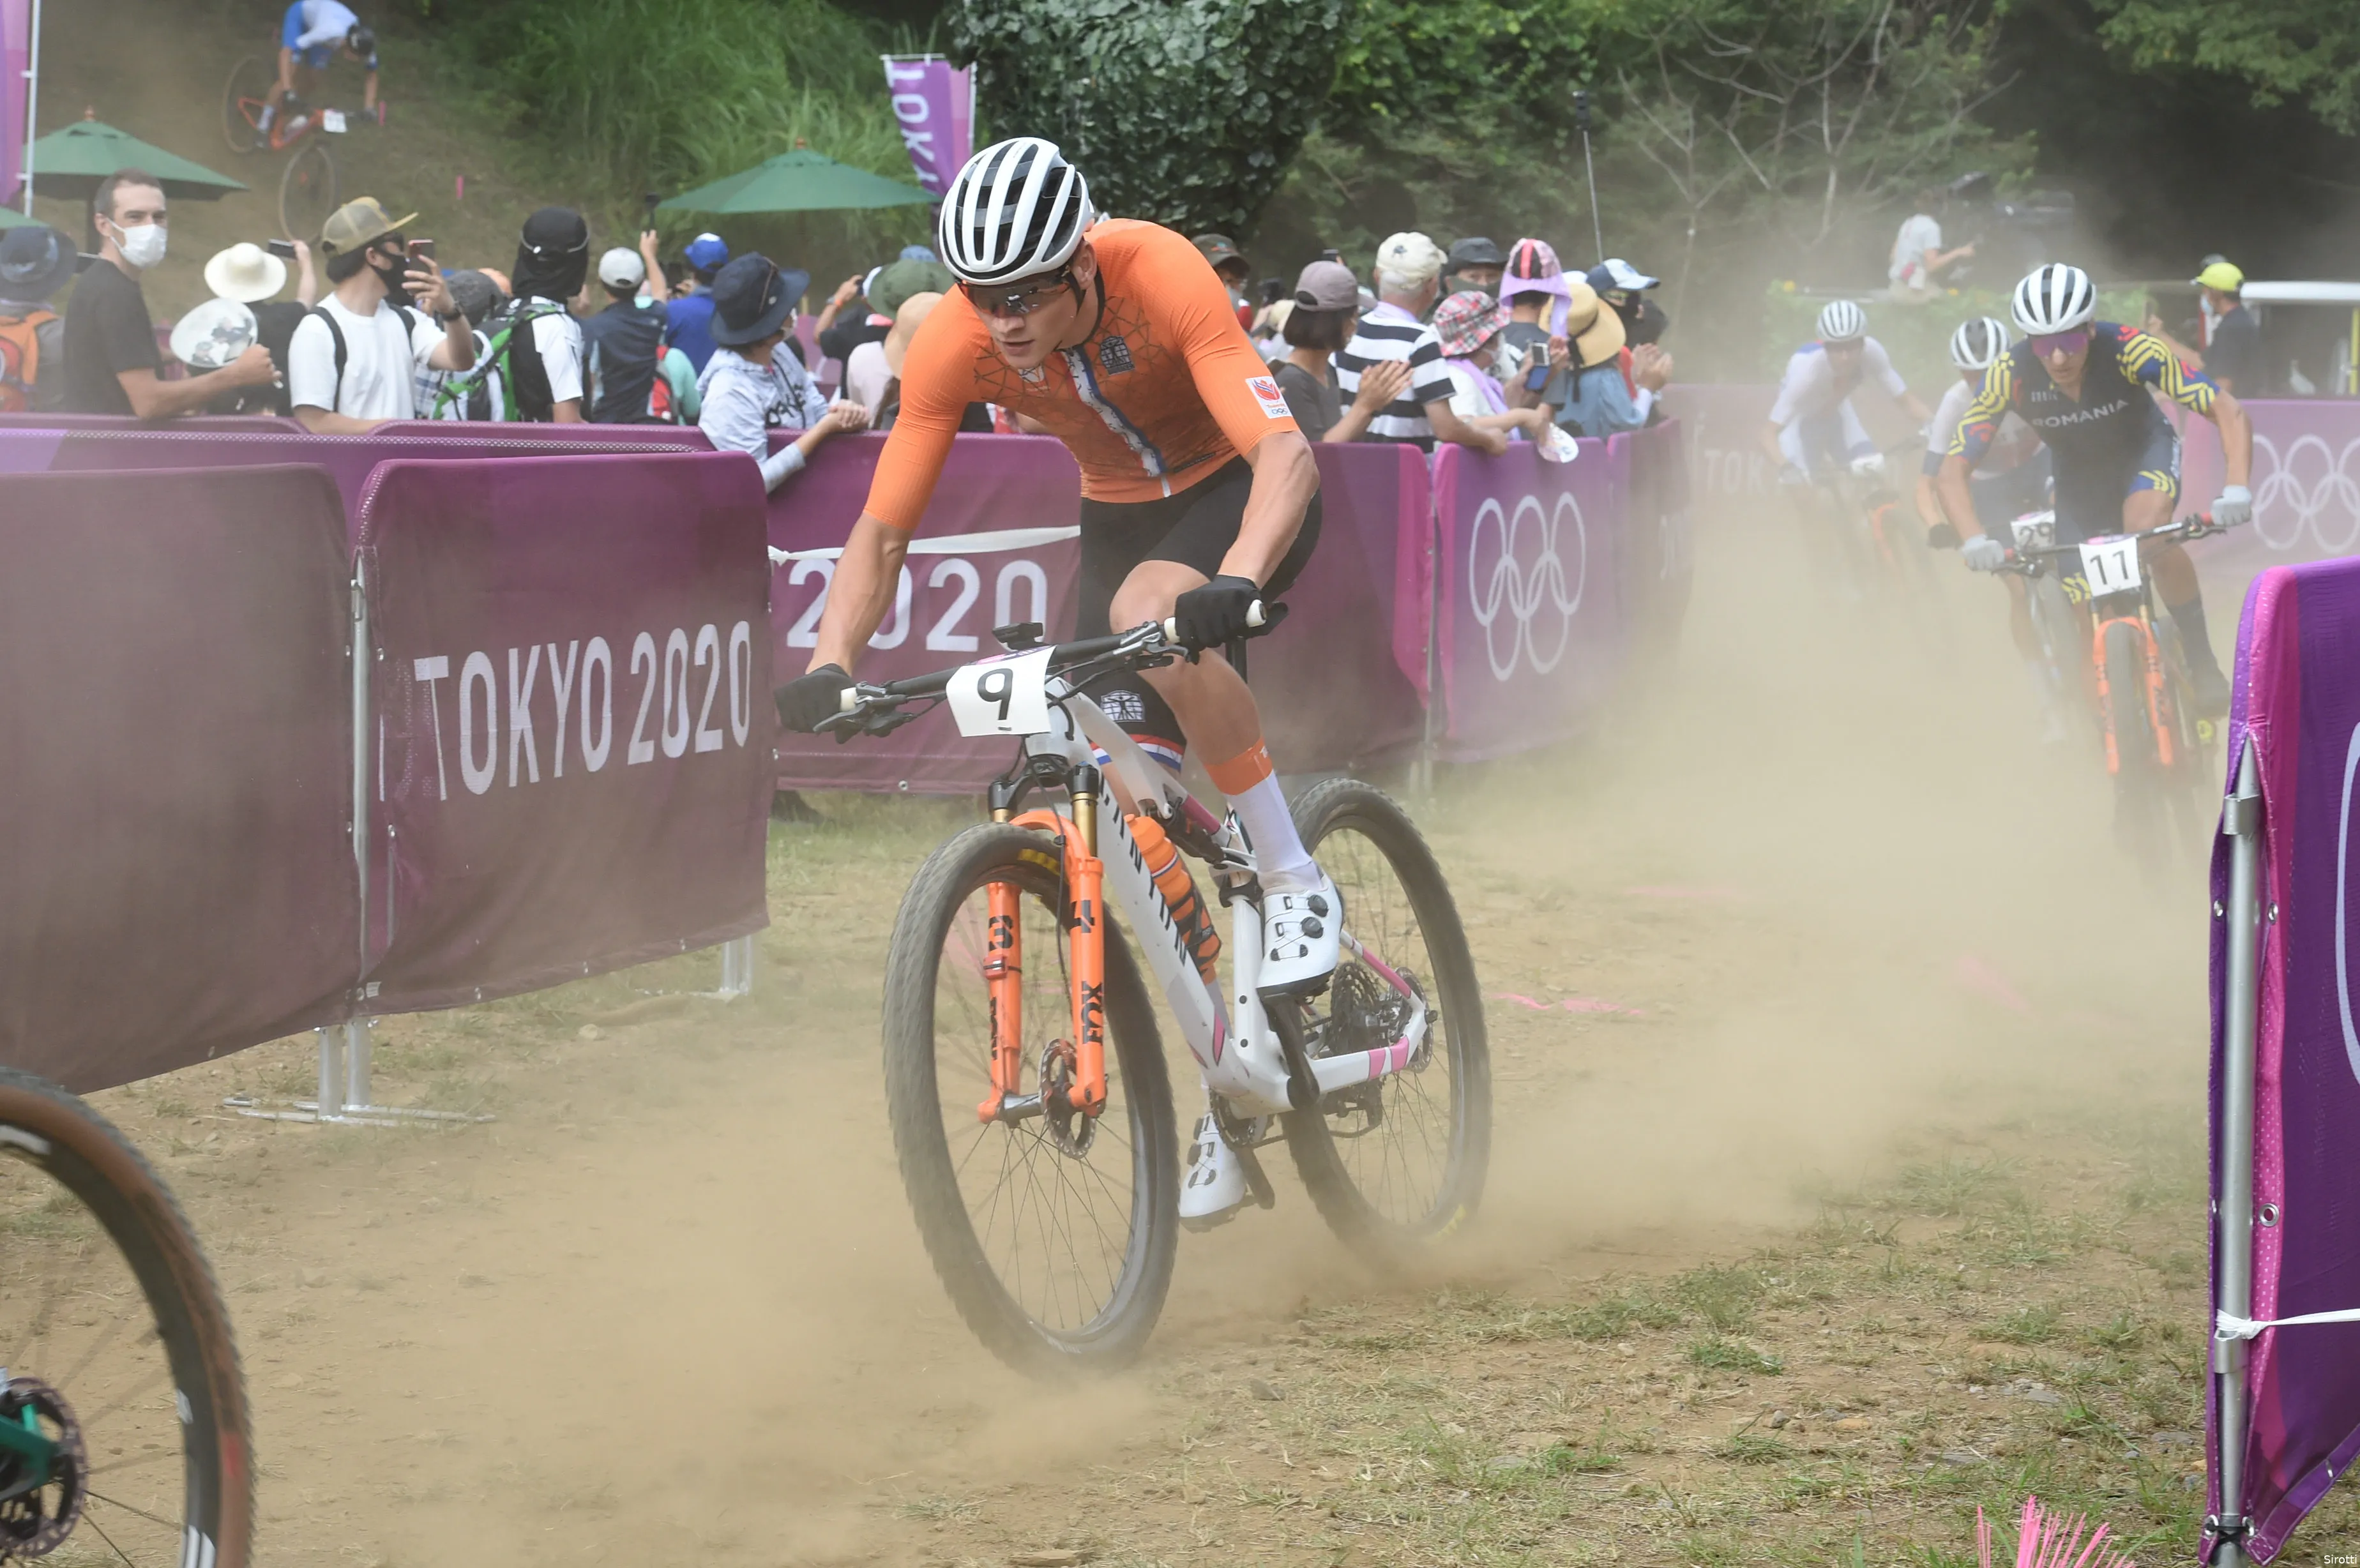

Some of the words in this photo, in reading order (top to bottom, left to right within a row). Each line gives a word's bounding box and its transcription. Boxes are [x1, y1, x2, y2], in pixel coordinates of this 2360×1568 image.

[884, 56, 939, 183] TOKY
[2032, 400, 2129, 427] ROMANIA
[1704, 450, 1785, 496] TOK
[2020, 522, 2053, 550] 29
[2090, 550, 2129, 585] 11
[414, 637, 612, 801] TOKYO
[628, 621, 750, 765] 2020
[978, 668, 1013, 721] 9
[1081, 981, 1103, 1046] FOX
